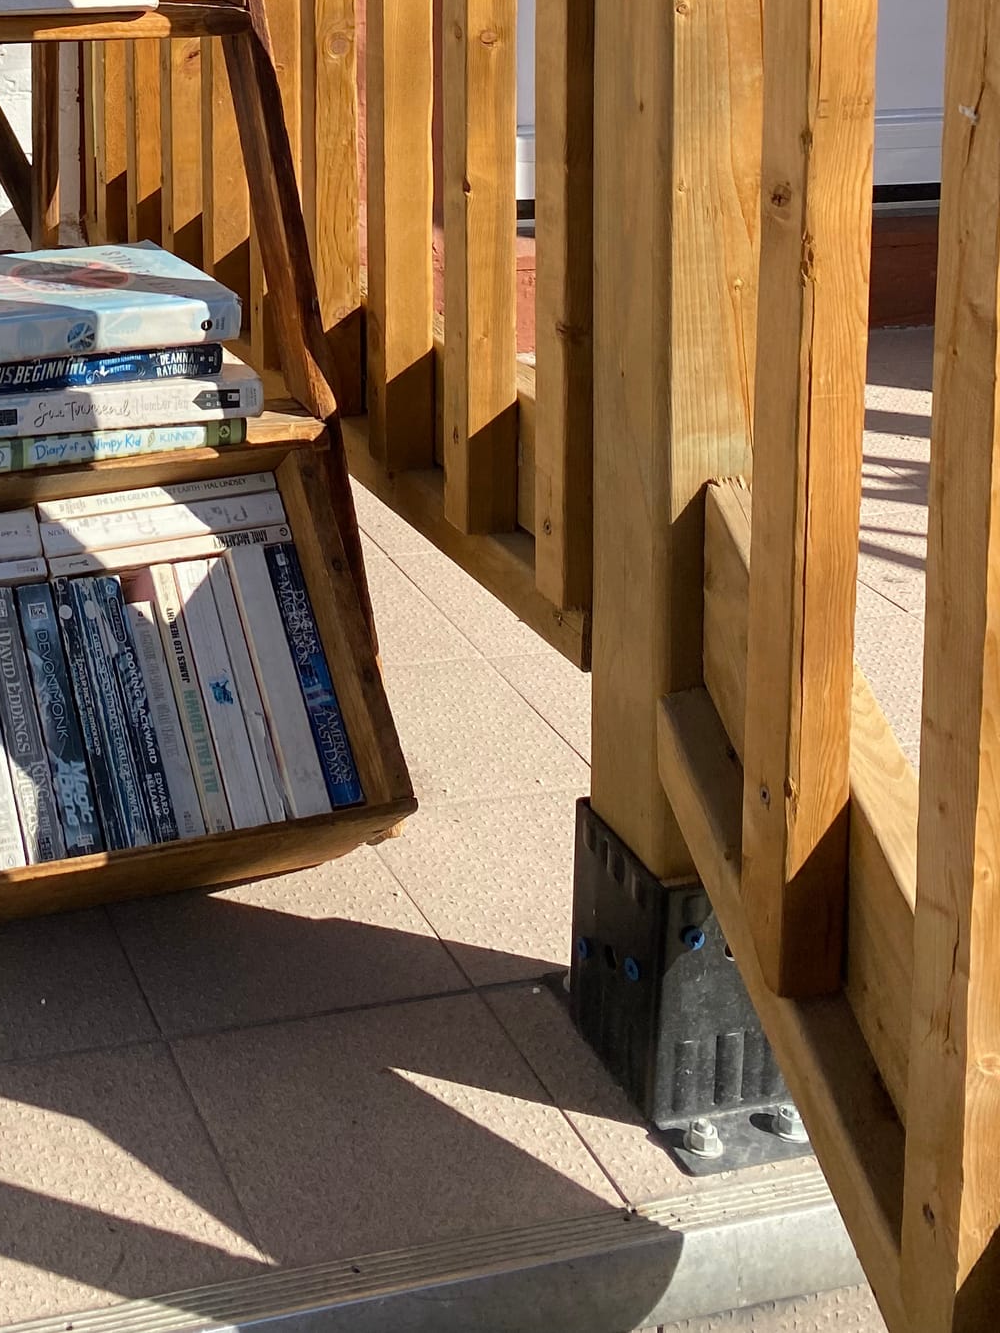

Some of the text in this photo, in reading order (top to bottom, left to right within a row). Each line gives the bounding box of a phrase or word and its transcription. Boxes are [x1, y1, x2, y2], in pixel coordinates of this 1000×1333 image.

[13, 356, 90, 385] BEGINNING
[156, 363, 199, 378] RAYBOURN
[159, 353, 195, 365] DEANNA
[35, 442, 67, 460] Diary
[69, 443, 79, 453] of
[88, 436, 122, 453] Wimpy
[124, 432, 142, 447] Kid
[159, 429, 198, 444] KINNEY
[96, 497, 110, 508] THE
[127, 491, 149, 503] GREAT
[176, 483, 200, 496] EARTH
[203, 481, 219, 491] HAL
[219, 478, 248, 490] LINDSEY
[294, 589, 319, 655] DOUGLAS
[174, 641, 185, 655] LEO
[177, 655, 191, 683] JAMES
[35, 630, 56, 687] DEVON
[49, 688, 70, 739] MONK
[75, 654, 88, 684] EDGAR
[86, 705, 101, 756] BURROUGHS
[124, 646, 158, 765] LOOKING BACKWARD
[6, 682, 31, 754] EDDINGS
[314, 713, 345, 785] LAST DAYS
[17, 764, 39, 834] MURGOS
[31, 761, 49, 803] KING
[70, 760, 94, 824] Magic
[145, 773, 162, 817] BELLAMY
[154, 772, 170, 816] EDWARD
